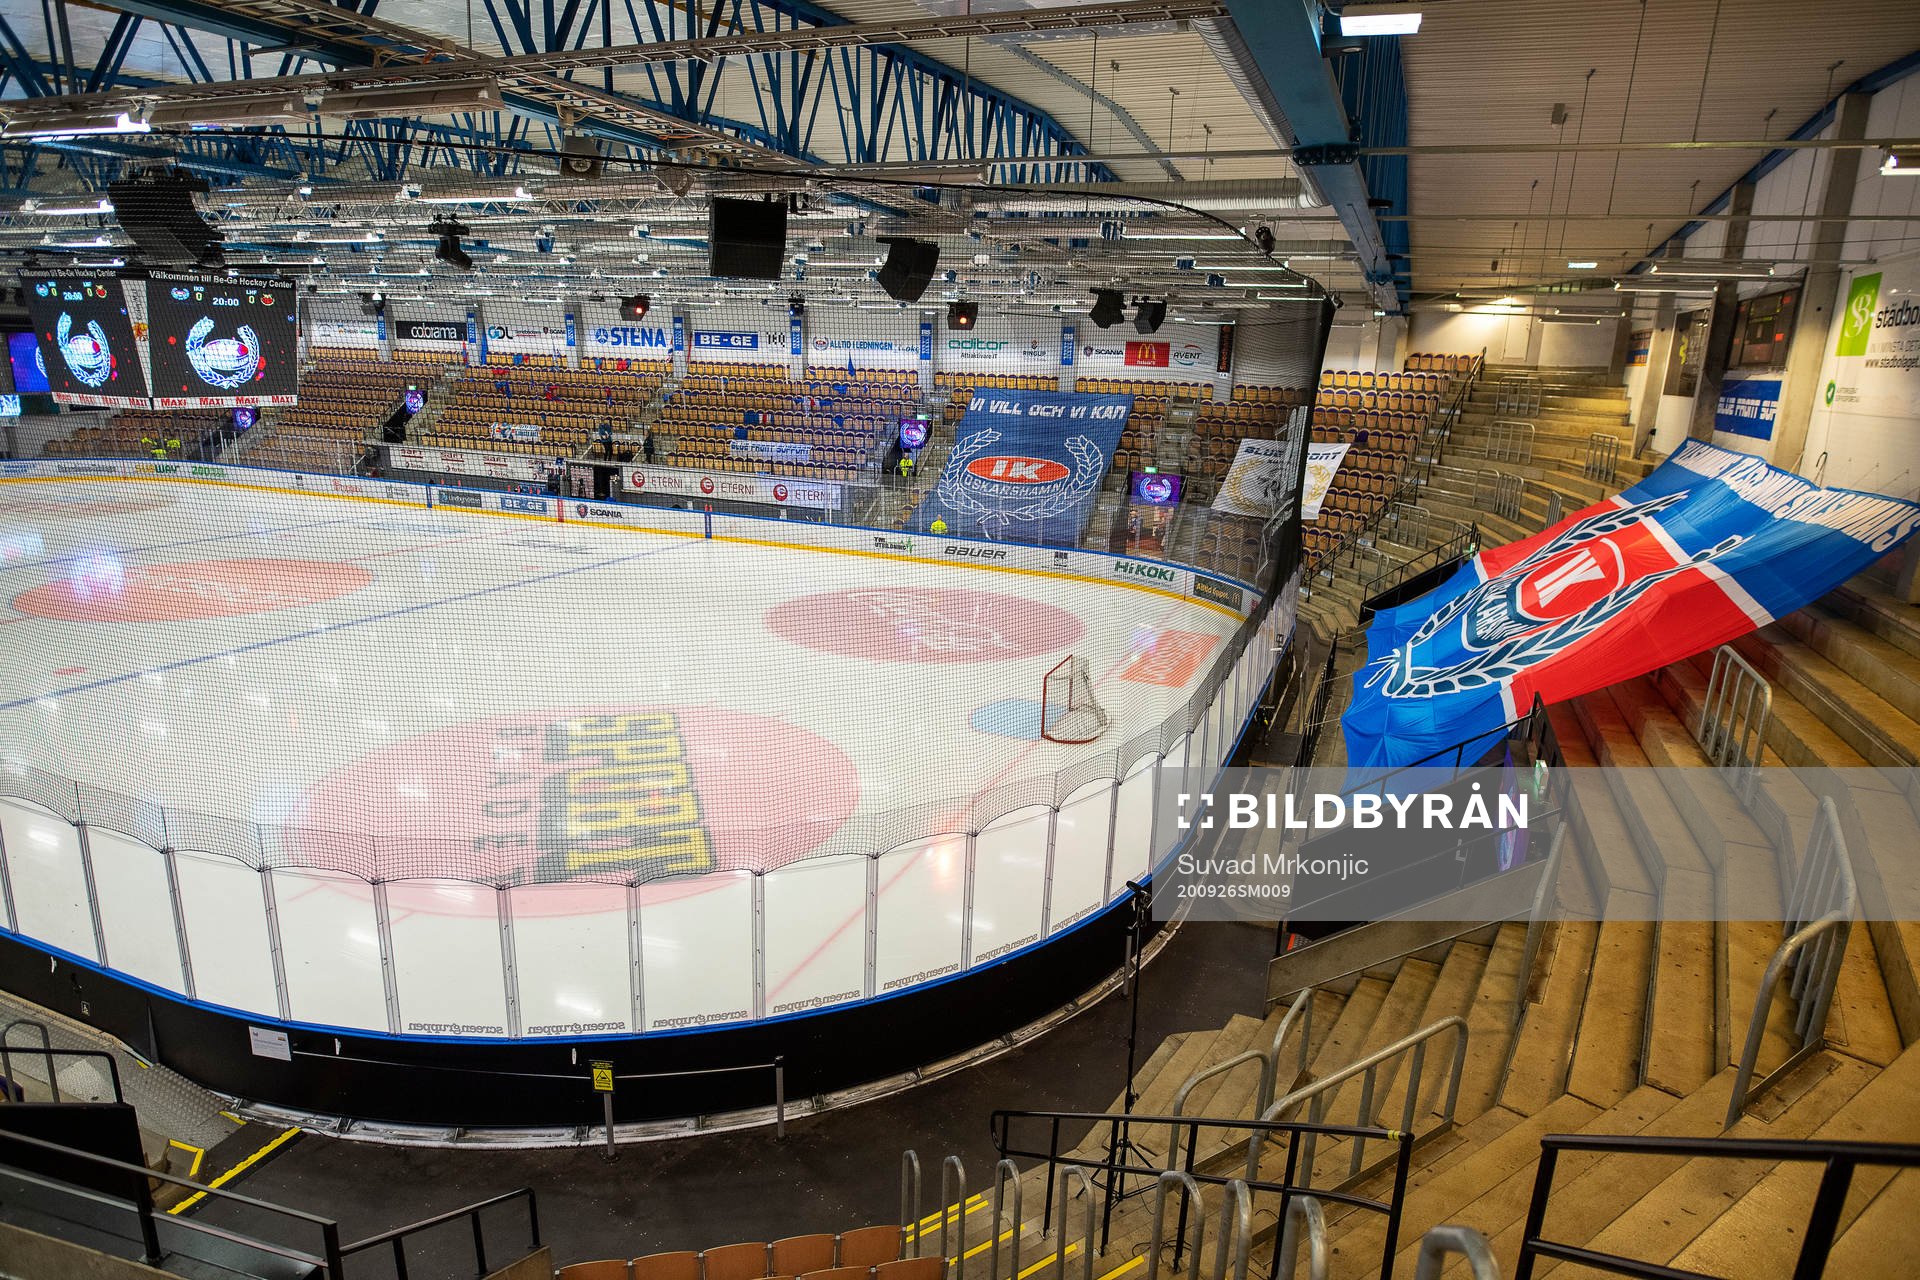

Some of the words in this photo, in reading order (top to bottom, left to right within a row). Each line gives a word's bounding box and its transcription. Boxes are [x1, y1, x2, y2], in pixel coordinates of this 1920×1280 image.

[58, 269, 75, 278] Be-Ge
[75, 270, 97, 279] Hockey
[149, 269, 199, 282] Välkommen
[201, 273, 212, 283] till
[213, 274, 238, 286] Be-Ge
[239, 278, 268, 290] Hockey
[269, 279, 293, 290] Center
[63, 292, 83, 301] 20:00
[196, 291, 203, 301] 0
[212, 297, 239, 307] 20:00
[249, 295, 255, 305] 0
[411, 322, 457, 339] colorama
[611, 326, 667, 348] STENA
[830, 340, 851, 349] ALLTID
[856, 341, 893, 351] LEDNINGEN
[1095, 348, 1124, 356] SCANIA
[1173, 351, 1203, 360] AVENT
[969, 397, 986, 412] VI
[989, 400, 1022, 416] VILL
[1028, 404, 1065, 418] OCH
[1070, 405, 1088, 419] VI
[1090, 405, 1126, 421] KAN
[1243, 446, 1285, 458] BLUE
[135, 464, 178, 475] SUBWAY
[992, 459, 1044, 480] IK
[651, 476, 683, 489] ETERNI
[963, 476, 1063, 497] OSKARSHAMN
[721, 483, 754, 496] ETERNI
[590, 508, 623, 519] SCANIA
[1114, 560, 1176, 582] HiKOKI
[1533, 549, 1606, 609] IK
[565, 711, 712, 874] SPORT
